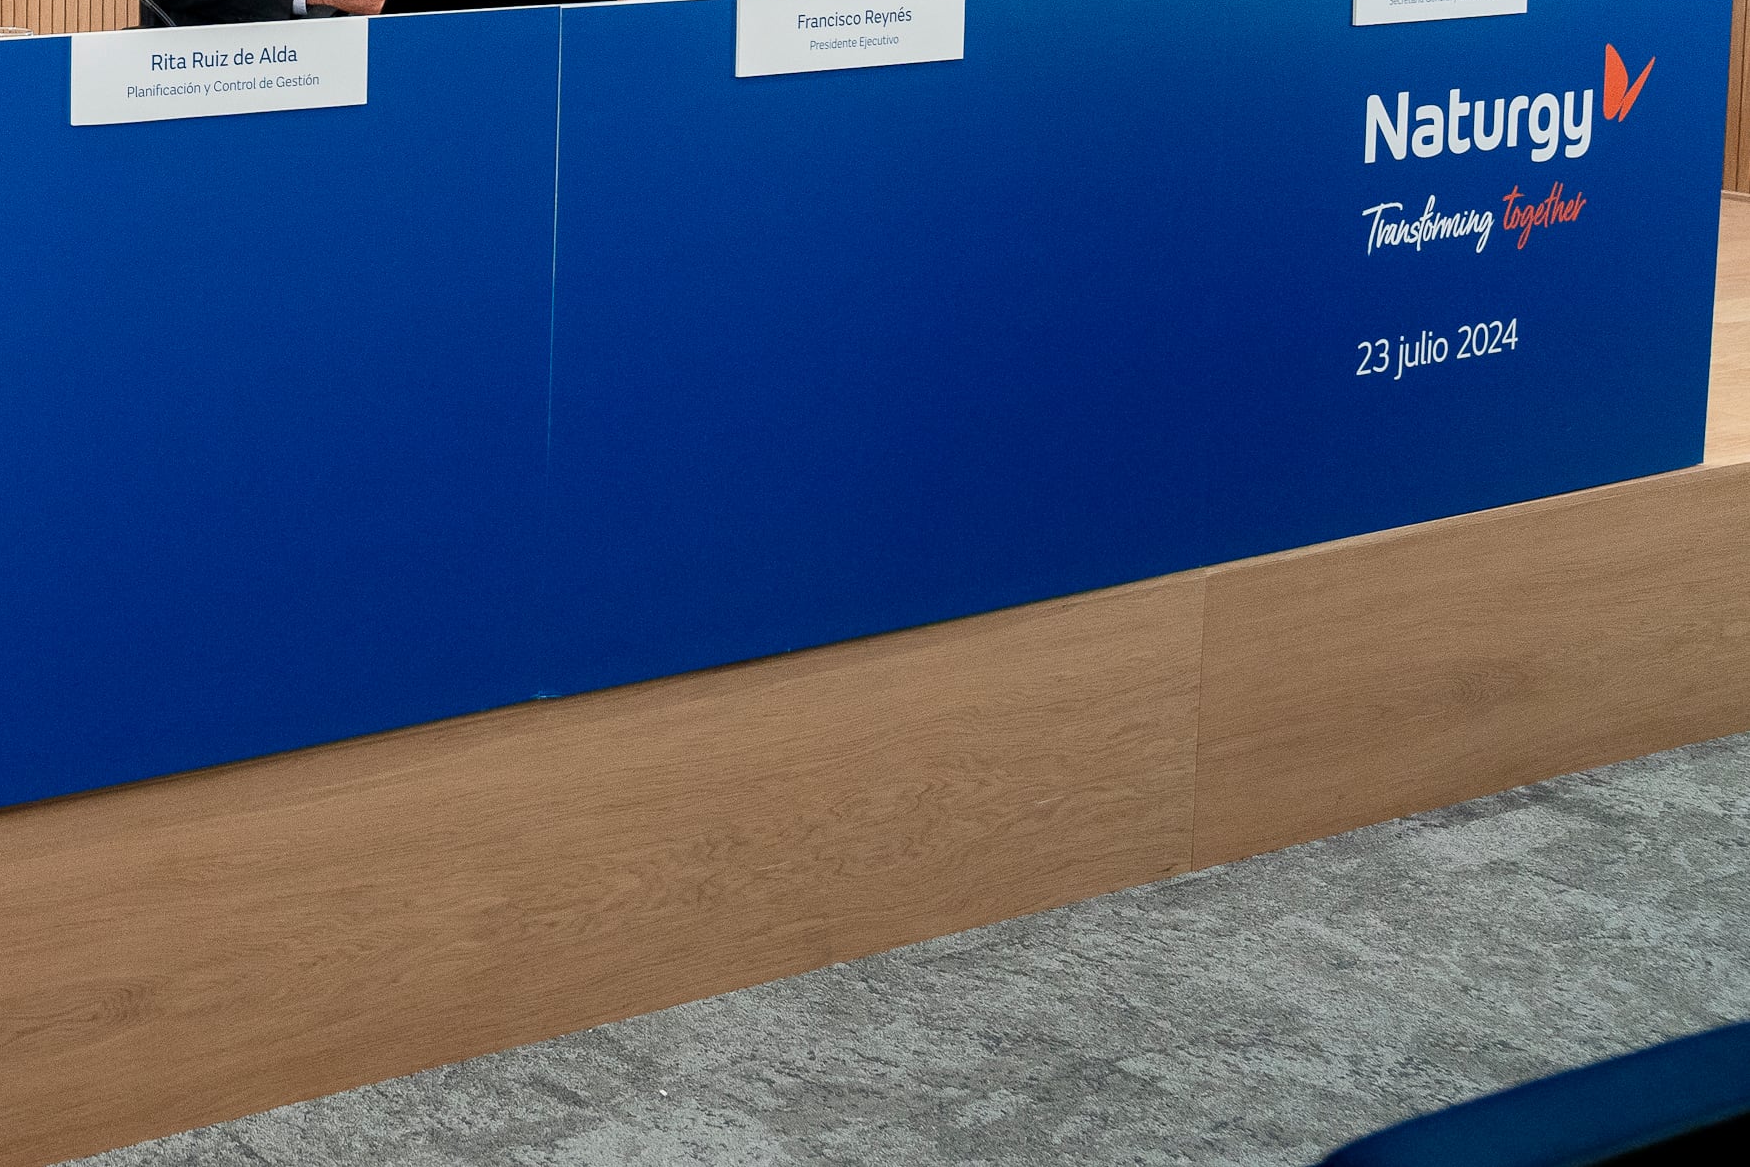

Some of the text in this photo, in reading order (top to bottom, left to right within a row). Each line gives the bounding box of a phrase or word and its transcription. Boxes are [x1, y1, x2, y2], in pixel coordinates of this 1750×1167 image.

[797, 6, 912, 29] Francisco Reynés
[810, 35, 899, 51] Presidente Ejecutivo
[150, 45, 298, 71] Rita Ruiz de Alda
[127, 73, 320, 98] Planificación y Control de Gestión
[1364, 89, 1593, 163] Naturgy
[1361, 181, 1587, 255] Transforming together
[1356, 318, 1519, 380] 23 julio 2024
